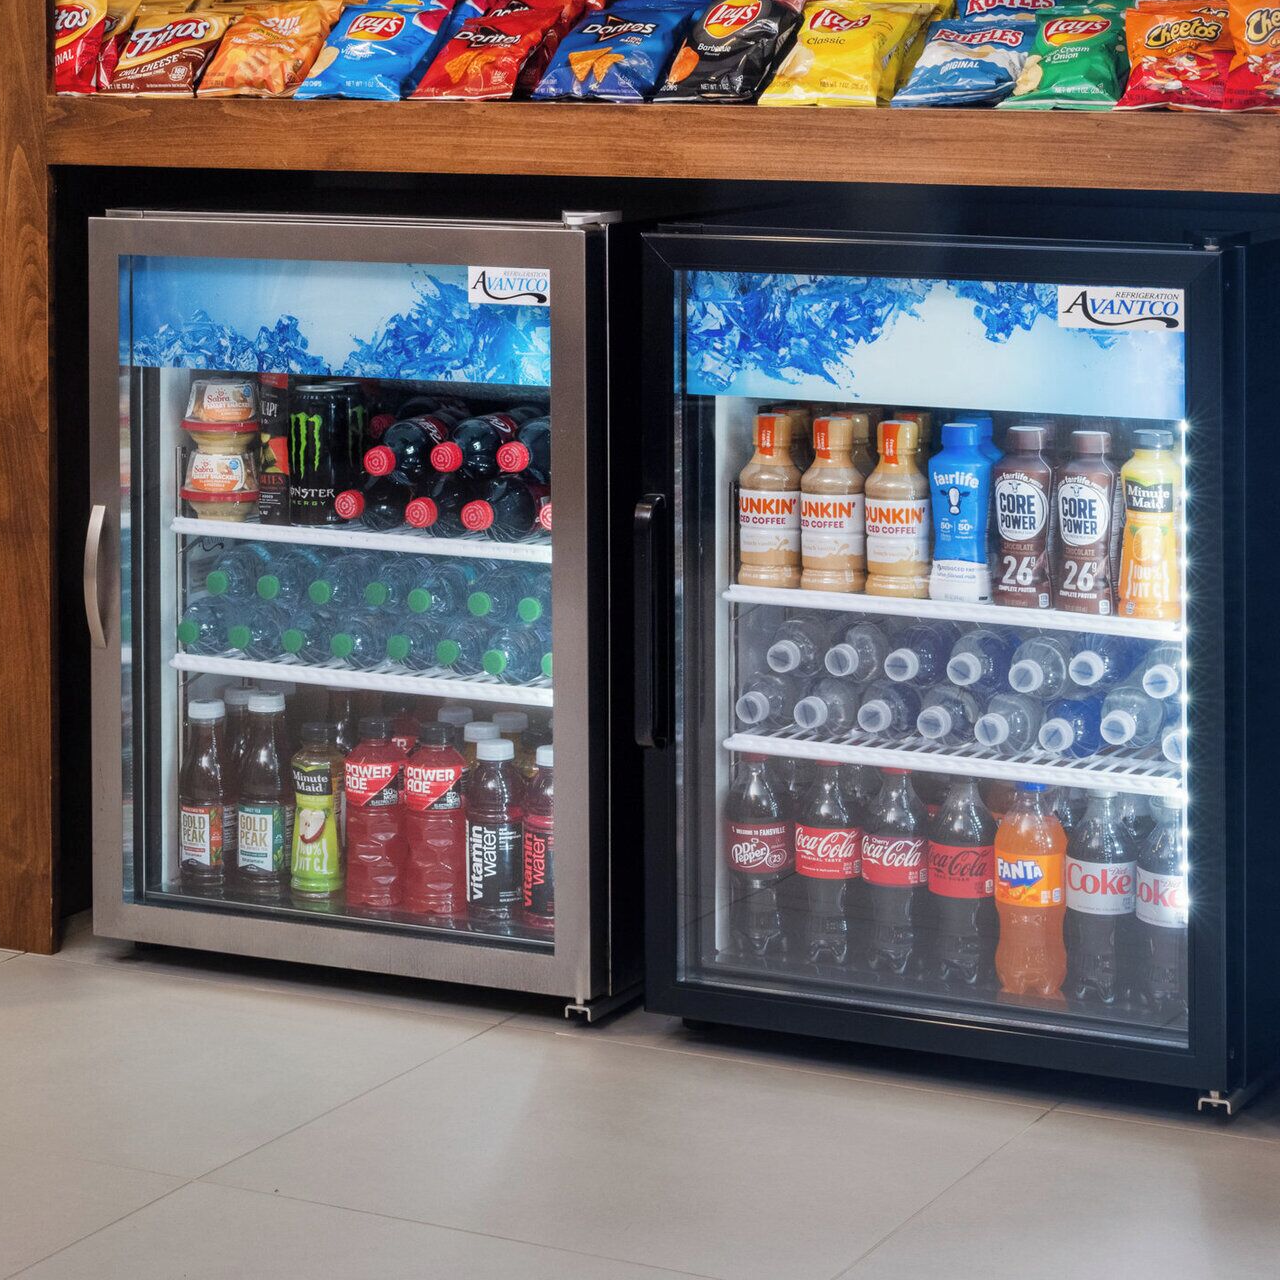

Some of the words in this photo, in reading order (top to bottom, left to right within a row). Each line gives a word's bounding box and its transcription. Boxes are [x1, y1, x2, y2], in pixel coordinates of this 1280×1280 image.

[55, 8, 90, 29] itos
[711, 3, 757, 27] Lay's
[349, 15, 404, 33] Lay's
[582, 23, 656, 35] Doritos
[126, 21, 210, 59] Fritos
[807, 36, 846, 45] Classic
[932, 27, 1024, 47] RUFFLES
[1146, 18, 1222, 48] Cheetos
[140, 53, 180, 74] CHEESE
[1053, 52, 1079, 62] Onion
[940, 61, 979, 74] ORIGINAL
[471, 270, 548, 295] AVANTCO
[1115, 291, 1180, 300] REFRIGERATION
[1062, 290, 1179, 319] AVANTCO
[207, 392, 230, 402] Sabra
[933, 472, 979, 489] fairlife
[1002, 472, 1028, 482] fairlife
[291, 487, 335, 499] ONSTER
[1128, 484, 1169, 498] Minute
[1000, 493, 1035, 515] CORE
[1062, 497, 1097, 519] CORE
[752, 517, 786, 525] COFFEE
[811, 521, 844, 529] COFFEE
[1001, 515, 1036, 530] POWER
[1063, 519, 1097, 535] POWER
[882, 526, 916, 535] COFFEE
[1004, 543, 1034, 551] CHOCOLATE
[1065, 548, 1095, 557] CHOCOLATE
[293, 770, 328, 783] Minute
[345, 763, 391, 778] POWER
[407, 767, 455, 782] POWER
[297, 781, 323, 792] Maid
[346, 778, 368, 790] ADE
[407, 781, 431, 794] ADE
[183, 813, 205, 829] GOLD
[240, 815, 268, 830] GOLD
[183, 829, 205, 843] PEAK
[240, 830, 267, 847] PEAK
[759, 826, 786, 836] FANSVILLE
[742, 841, 756, 854] Dr
[871, 837, 889, 846] Cherry
[470, 825, 483, 900] vitamin
[483, 827, 497, 878] water
[734, 847, 767, 865] Pepper
[523, 833, 534, 907] vitamin
[533, 834, 546, 886] water
[997, 858, 1042, 880] FANTA
[1068, 863, 1132, 895] Coke
